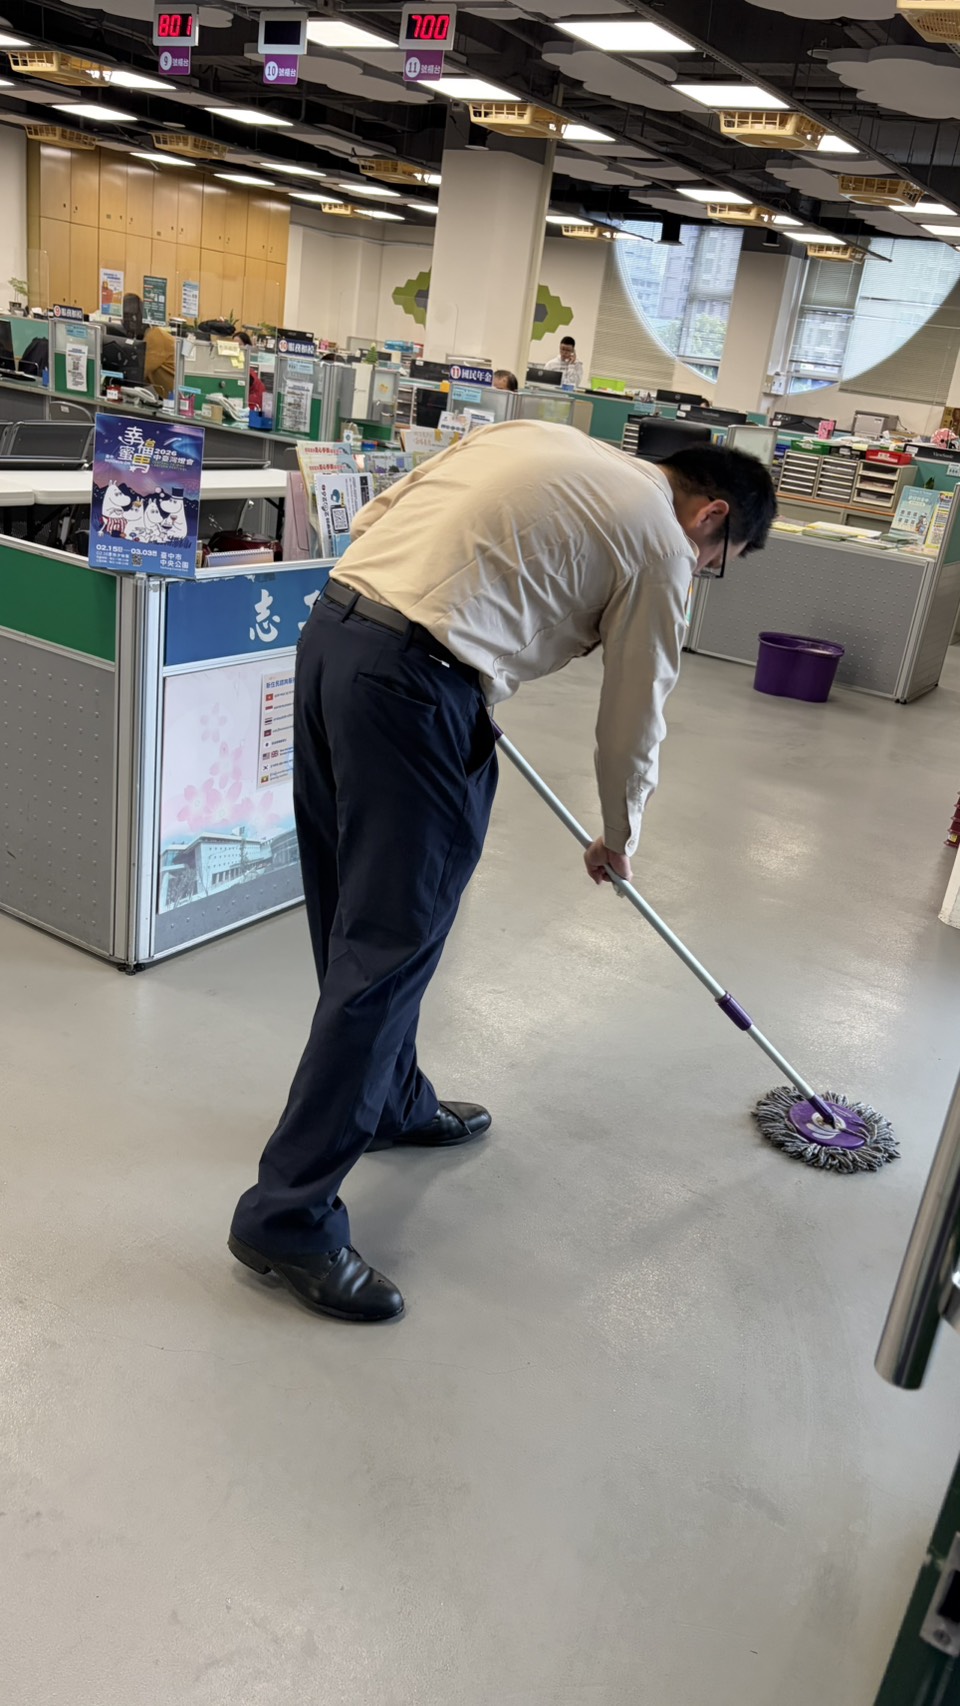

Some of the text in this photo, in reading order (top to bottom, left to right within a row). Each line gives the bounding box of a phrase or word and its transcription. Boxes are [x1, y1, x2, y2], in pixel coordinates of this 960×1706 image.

[158, 14, 193, 37] 801
[411, 15, 450, 40] 700
[461, 368, 492, 383] 國民年金
[154, 448, 178, 457] 2026
[160, 559, 189, 570] 中央公園
